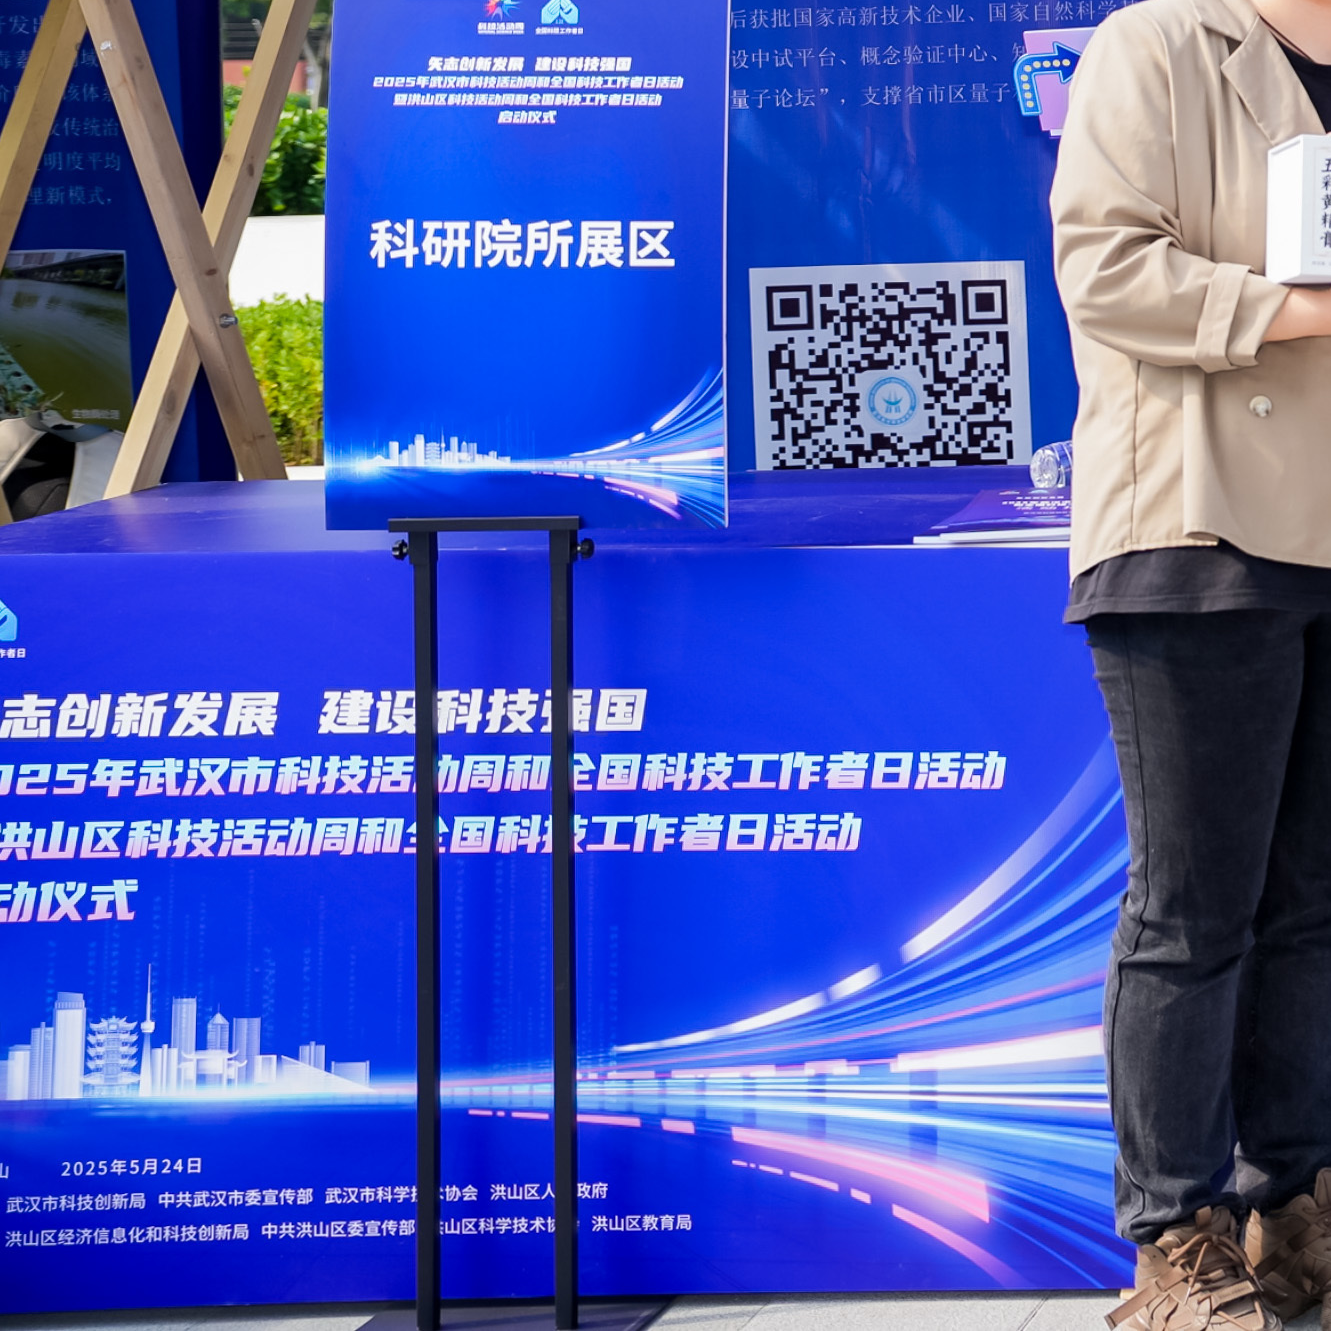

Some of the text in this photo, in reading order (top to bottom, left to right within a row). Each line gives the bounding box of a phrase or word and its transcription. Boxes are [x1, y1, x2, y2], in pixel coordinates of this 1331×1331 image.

[427, 56, 632, 72] 矢志创新发展 建设科技强国
[373, 75, 684, 91] 2025年武汉市科技活动周和全国科技工作者日活动
[393, 93, 663, 108] 暨洪山区科技活动周和全国科技工作者日活动
[497, 110, 557, 125] 启动仪式
[369, 218, 676, 270] 科研院所展区
[0, 691, 281, 738] 志创新发展
[60, 1156, 203, 1177] 2025年5月24日
[5, 1192, 147, 1215] 武汉市科技创新局
[157, 1187, 314, 1210] 中共武汉市委宣传部
[489, 1182, 609, 1202] 洪山区人政府
[5, 1214, 693, 1249] 洪山区经济信息化和科技创新局 中共洪山区委宣传部 洪山区教育局
